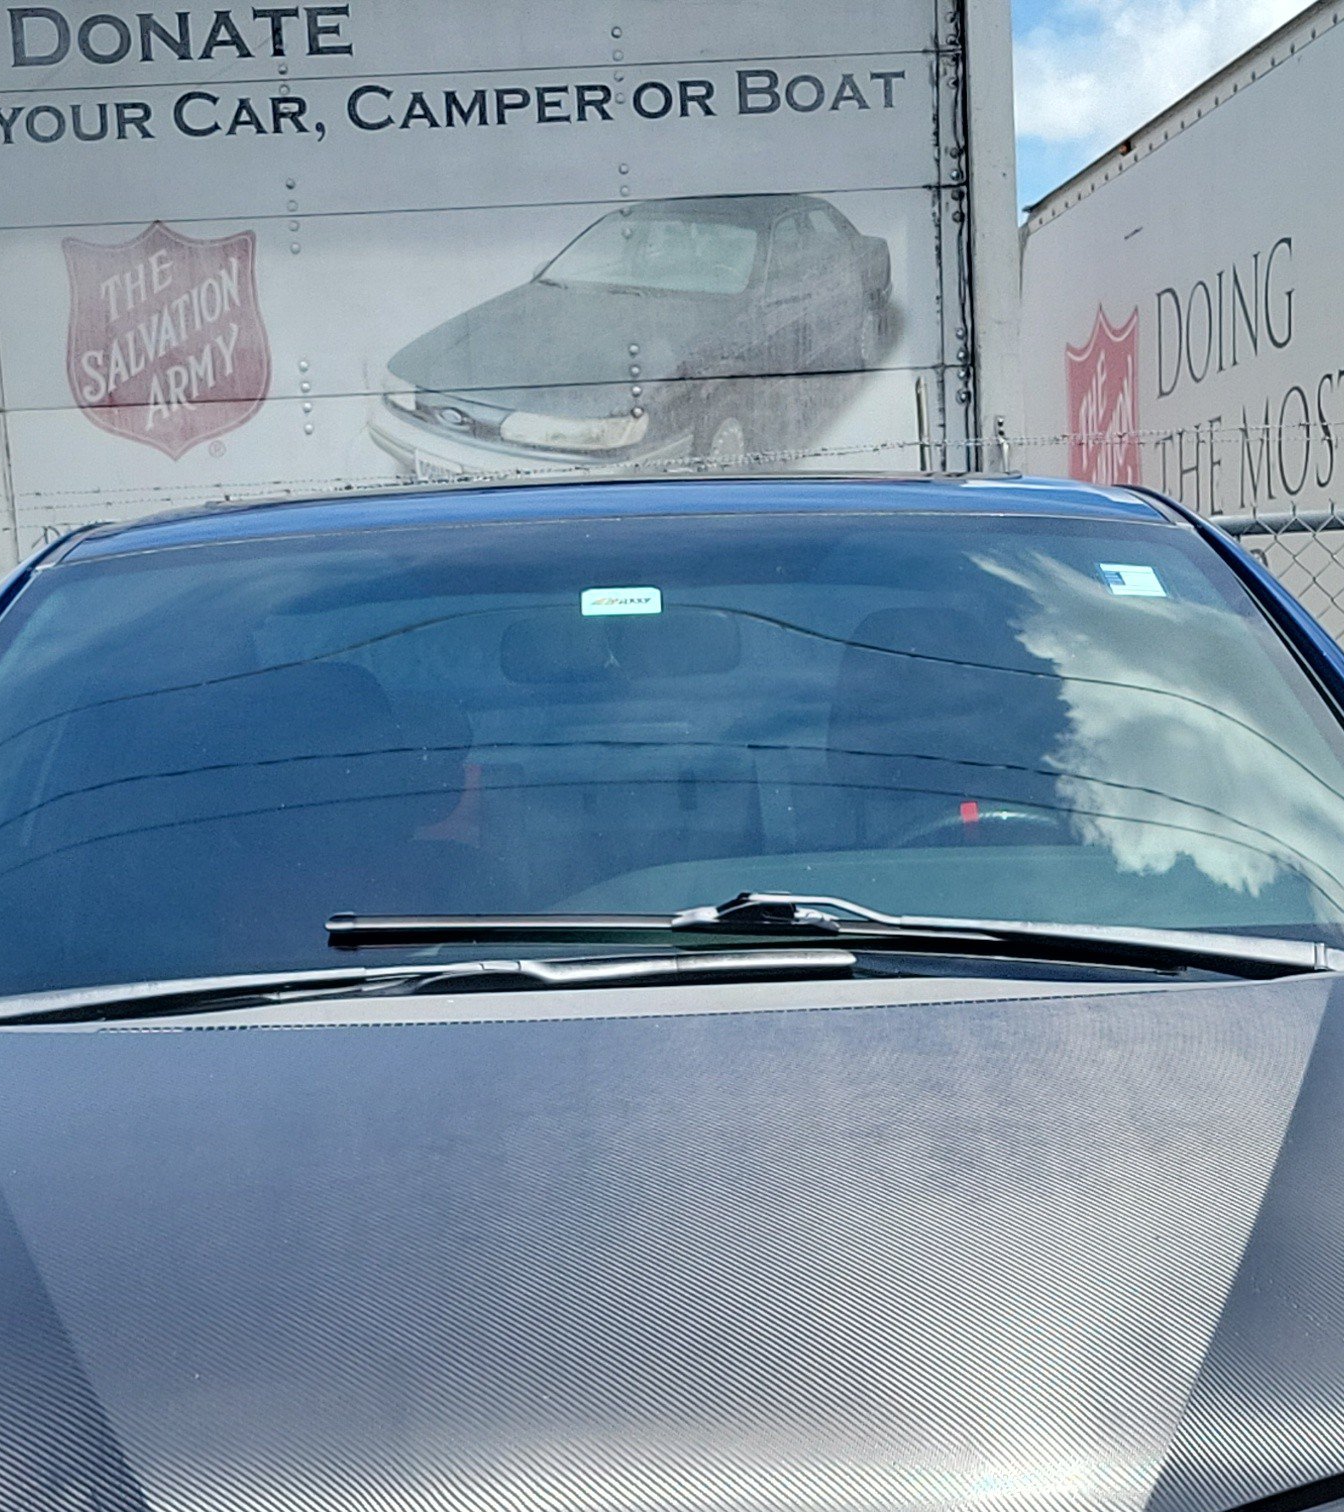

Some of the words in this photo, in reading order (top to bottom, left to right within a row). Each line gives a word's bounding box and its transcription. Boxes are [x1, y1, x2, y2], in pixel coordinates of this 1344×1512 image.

[7, 4, 353, 68] DONATE
[173, 90, 326, 142] CAR,
[347, 84, 614, 131] CAMPER
[632, 80, 718, 120] OR
[736, 68, 906, 115] BOAT
[80, 256, 242, 403] SALVATION
[100, 249, 174, 323] THE
[1156, 237, 1294, 399] DOING
[145, 322, 239, 432] ARMY
[1154, 415, 1224, 515] THE
